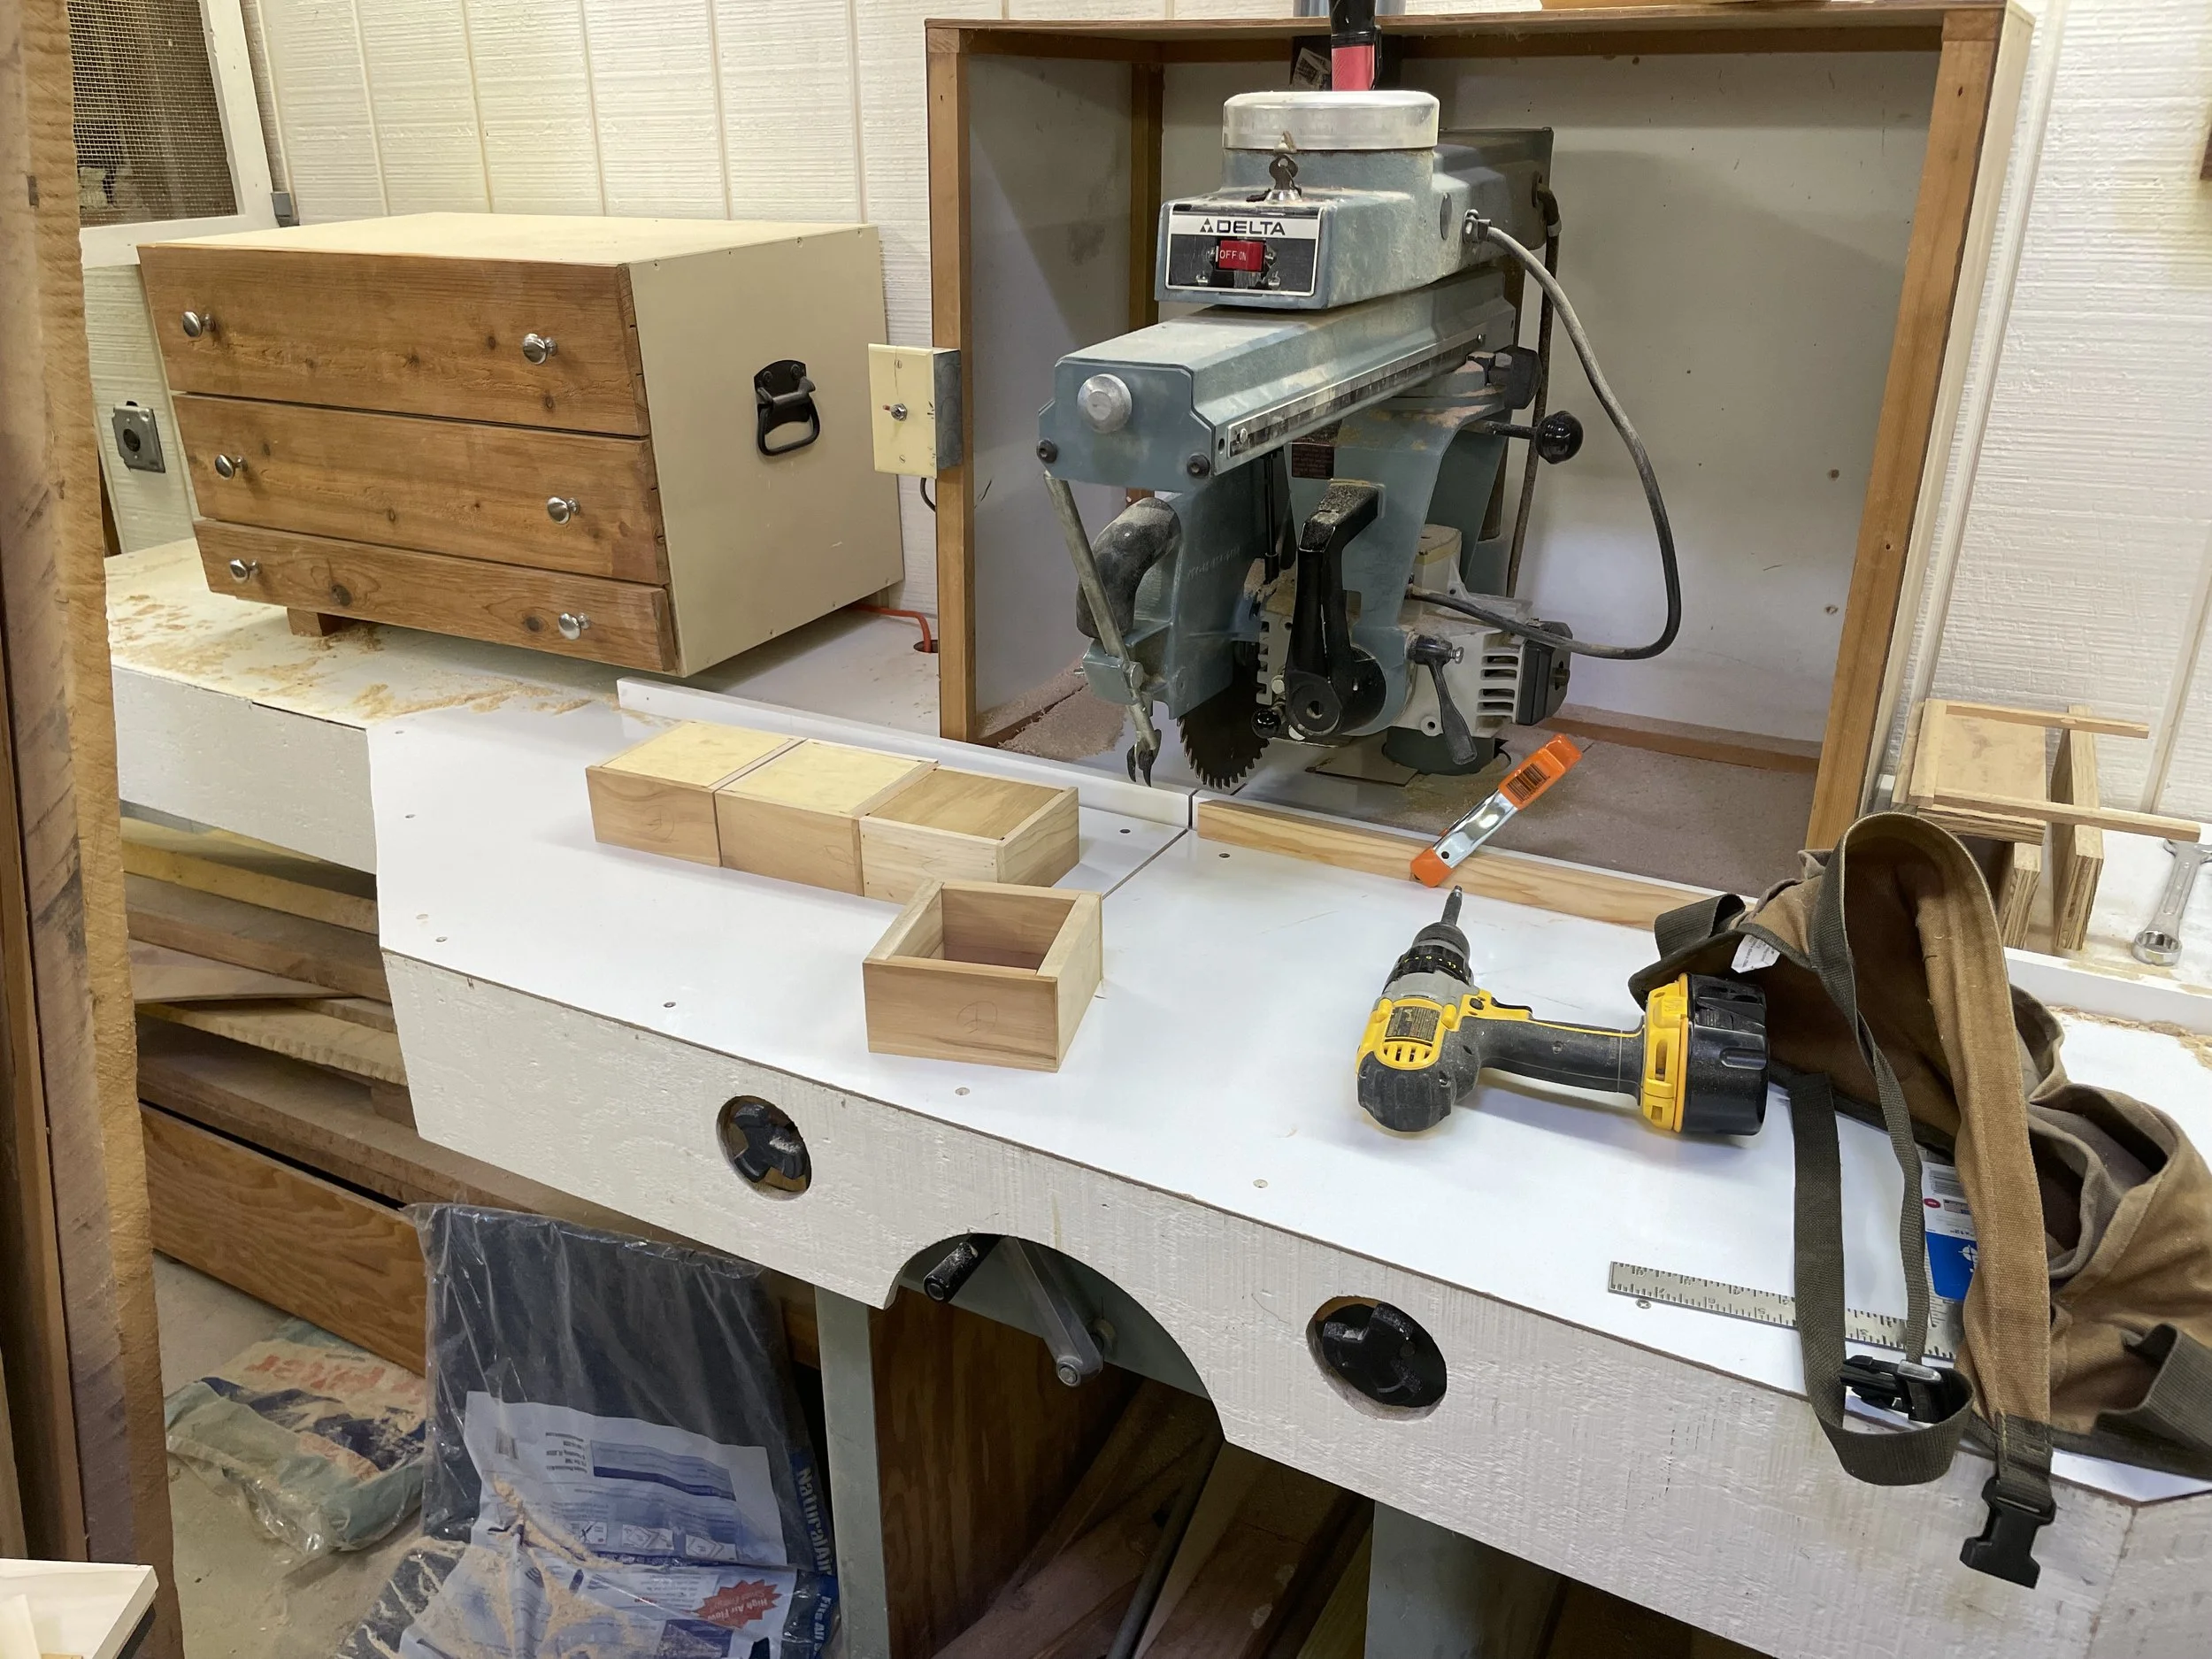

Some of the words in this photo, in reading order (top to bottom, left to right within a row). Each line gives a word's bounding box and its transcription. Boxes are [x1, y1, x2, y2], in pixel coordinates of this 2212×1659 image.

[1217, 219, 1285, 235] DELTA
[1219, 250, 1237, 259] OFF
[1239, 251, 1247, 261] ON
[732, 1604, 744, 1613] Air
[746, 1598, 768, 1609] High
[708, 1609, 729, 1621] Flow
[813, 1623, 826, 1646] All
